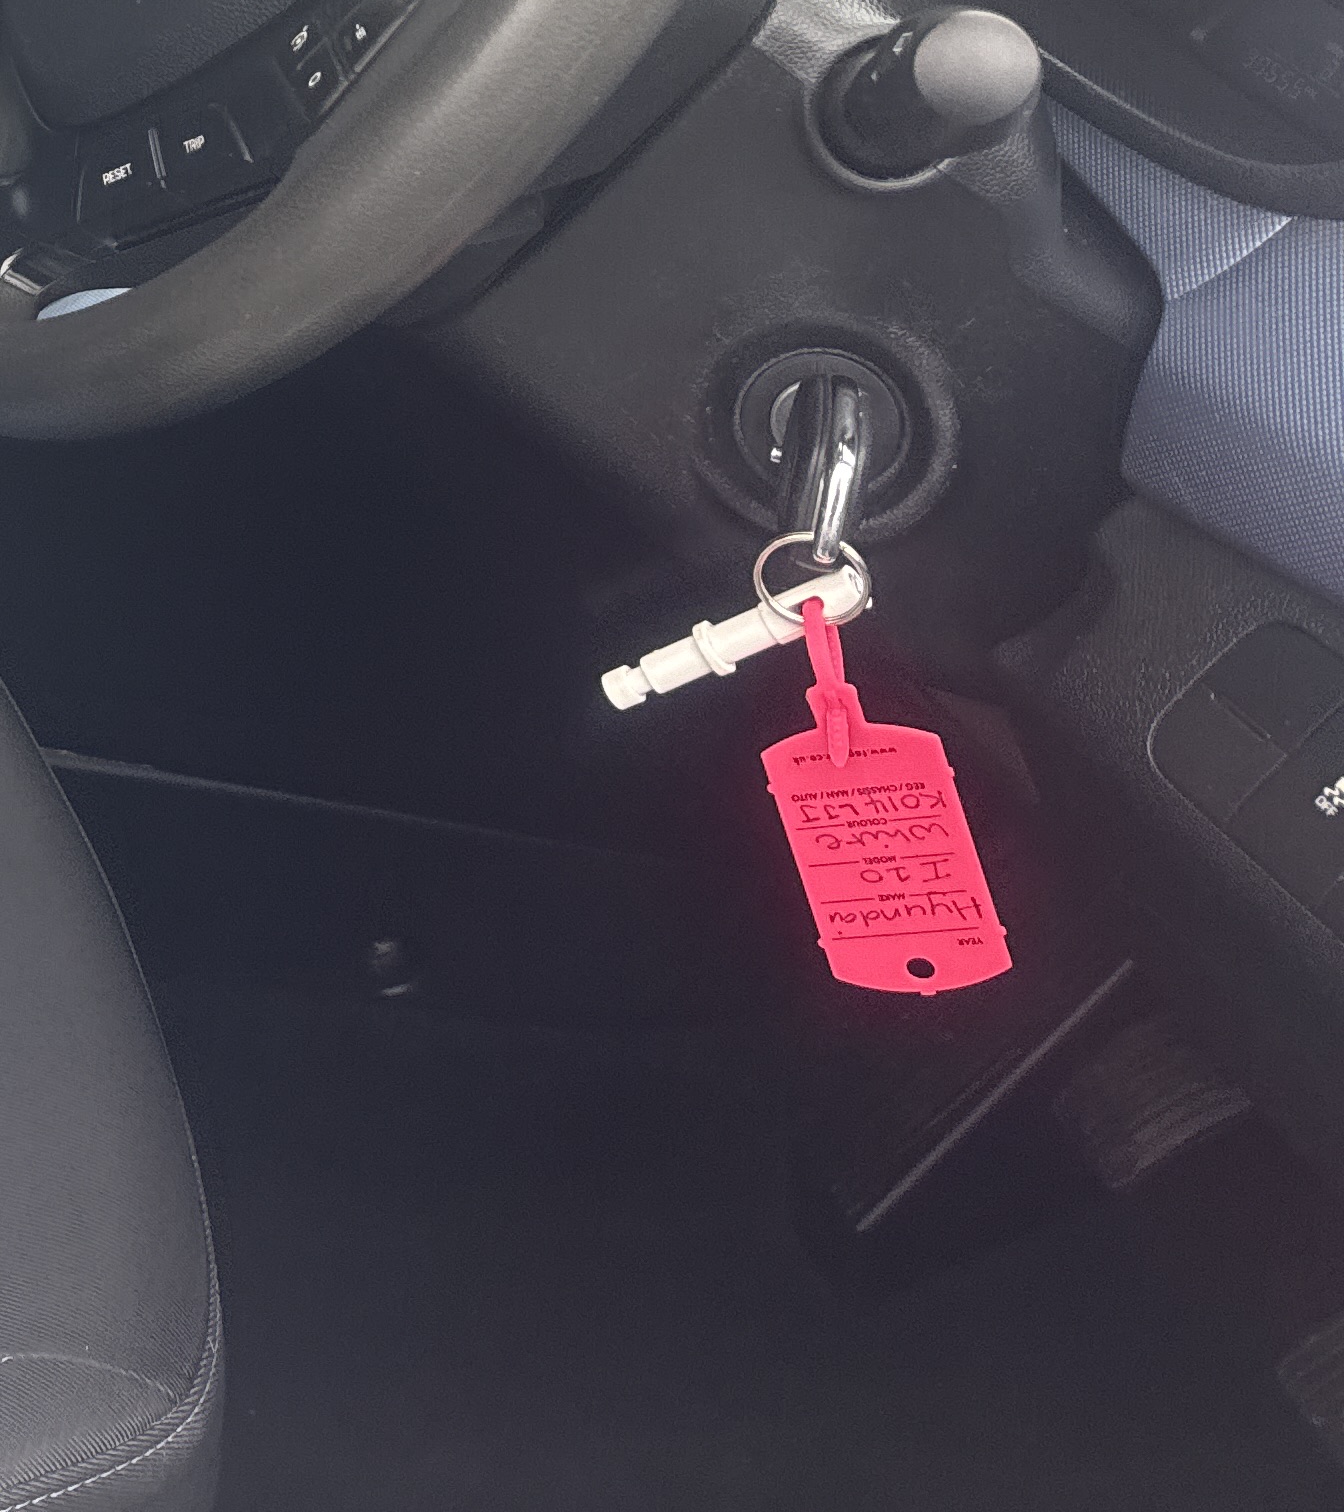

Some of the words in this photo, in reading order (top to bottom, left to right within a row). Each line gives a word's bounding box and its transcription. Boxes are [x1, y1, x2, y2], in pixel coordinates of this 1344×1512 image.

[182, 134, 205, 154] TRIP
[102, 162, 132, 186] RESET
[791, 792, 818, 802] AUTO
[846, 818, 888, 828] COLOUR
[863, 855, 897, 865] MODEL
[878, 892, 906, 902] MAKE
[829, 891, 983, 935] Hyundai
[957, 937, 984, 946] YEAR
